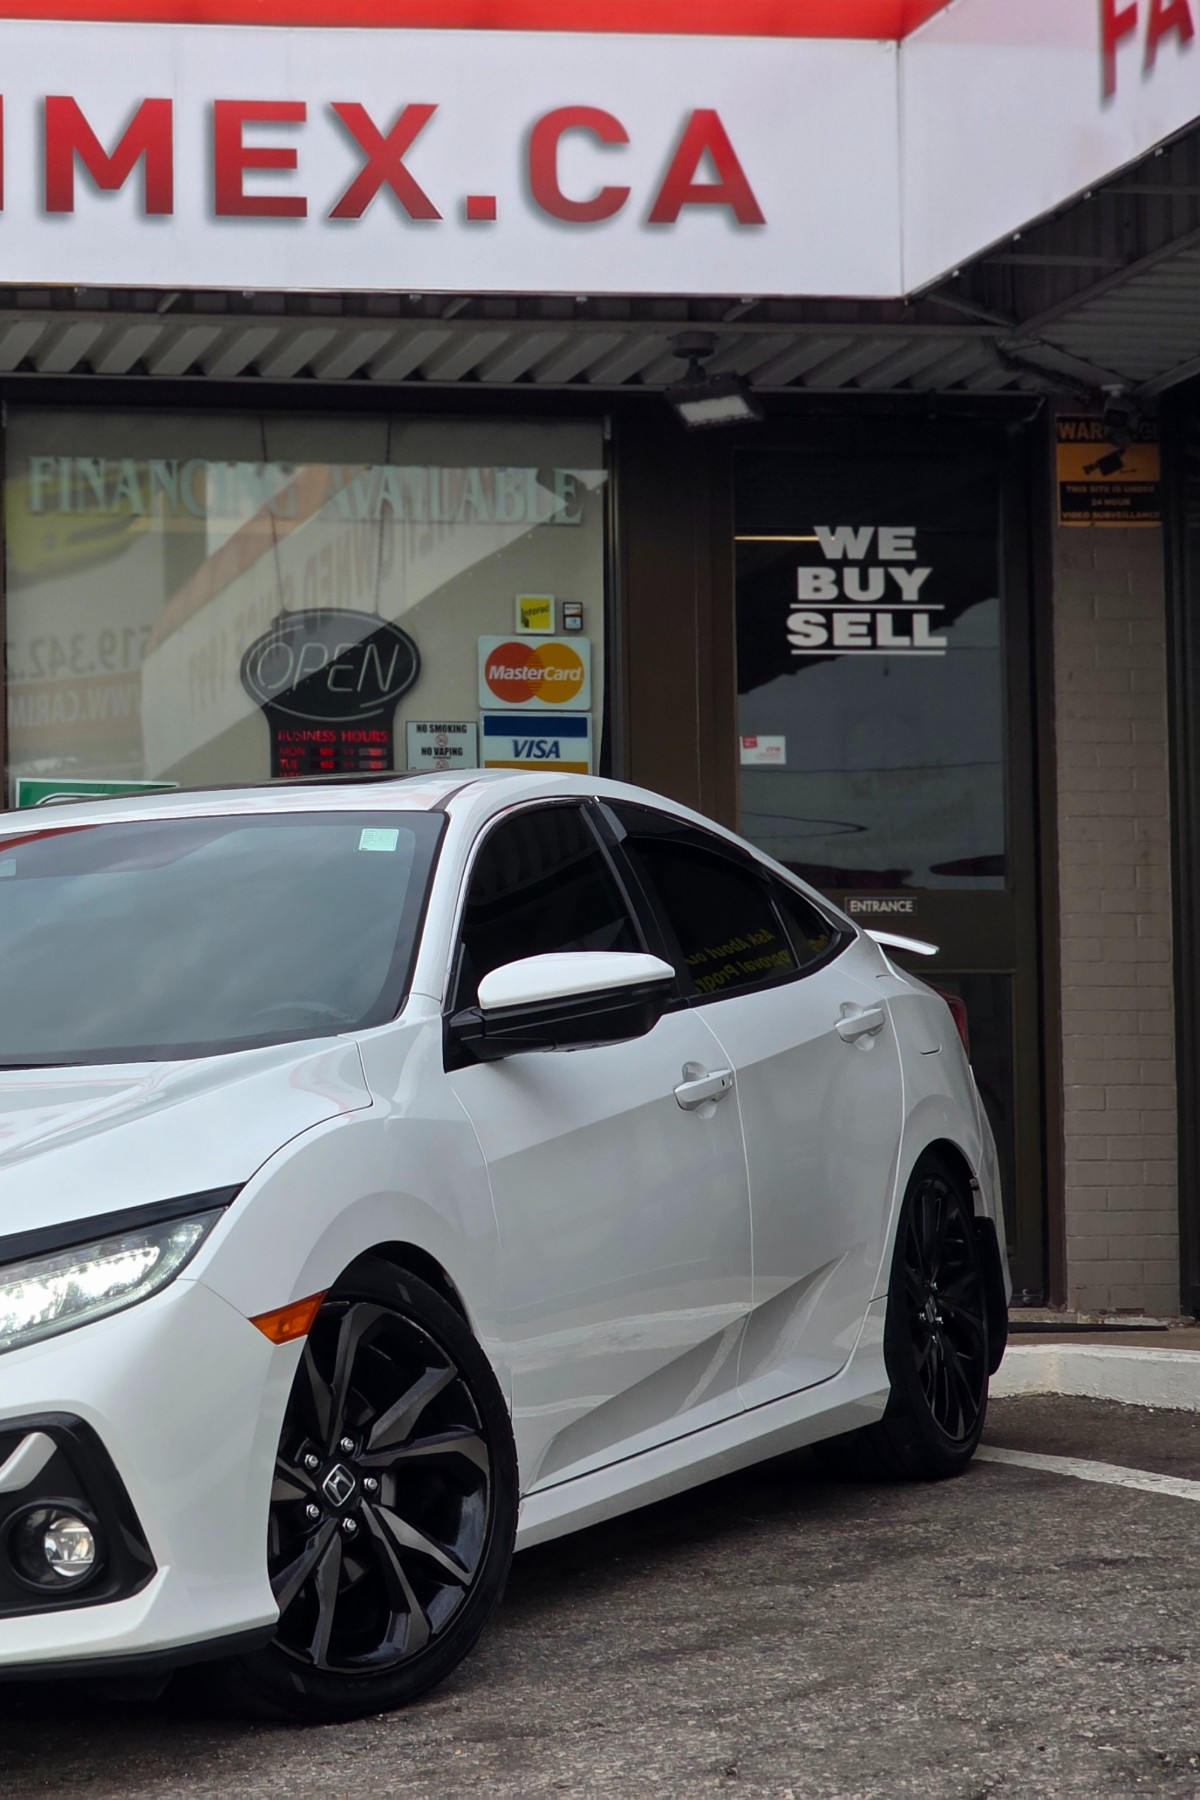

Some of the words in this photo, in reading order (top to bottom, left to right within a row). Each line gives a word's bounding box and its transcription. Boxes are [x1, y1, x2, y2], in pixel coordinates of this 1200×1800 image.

[813, 525, 917, 561] WE
[796, 566, 933, 601] BUY
[786, 612, 948, 648] SELL
[256, 641, 400, 693] OPEN
[488, 665, 582, 681] MasterCard
[278, 730, 337, 743] BUSINESS
[341, 730, 389, 743] HOURS
[416, 724, 428, 733] NO
[429, 724, 467, 733] SMOKING
[421, 747, 432, 756] NO
[434, 747, 464, 756] VAPING
[512, 739, 561, 759] VISA
[850, 899, 913, 913] ENTRANCE
